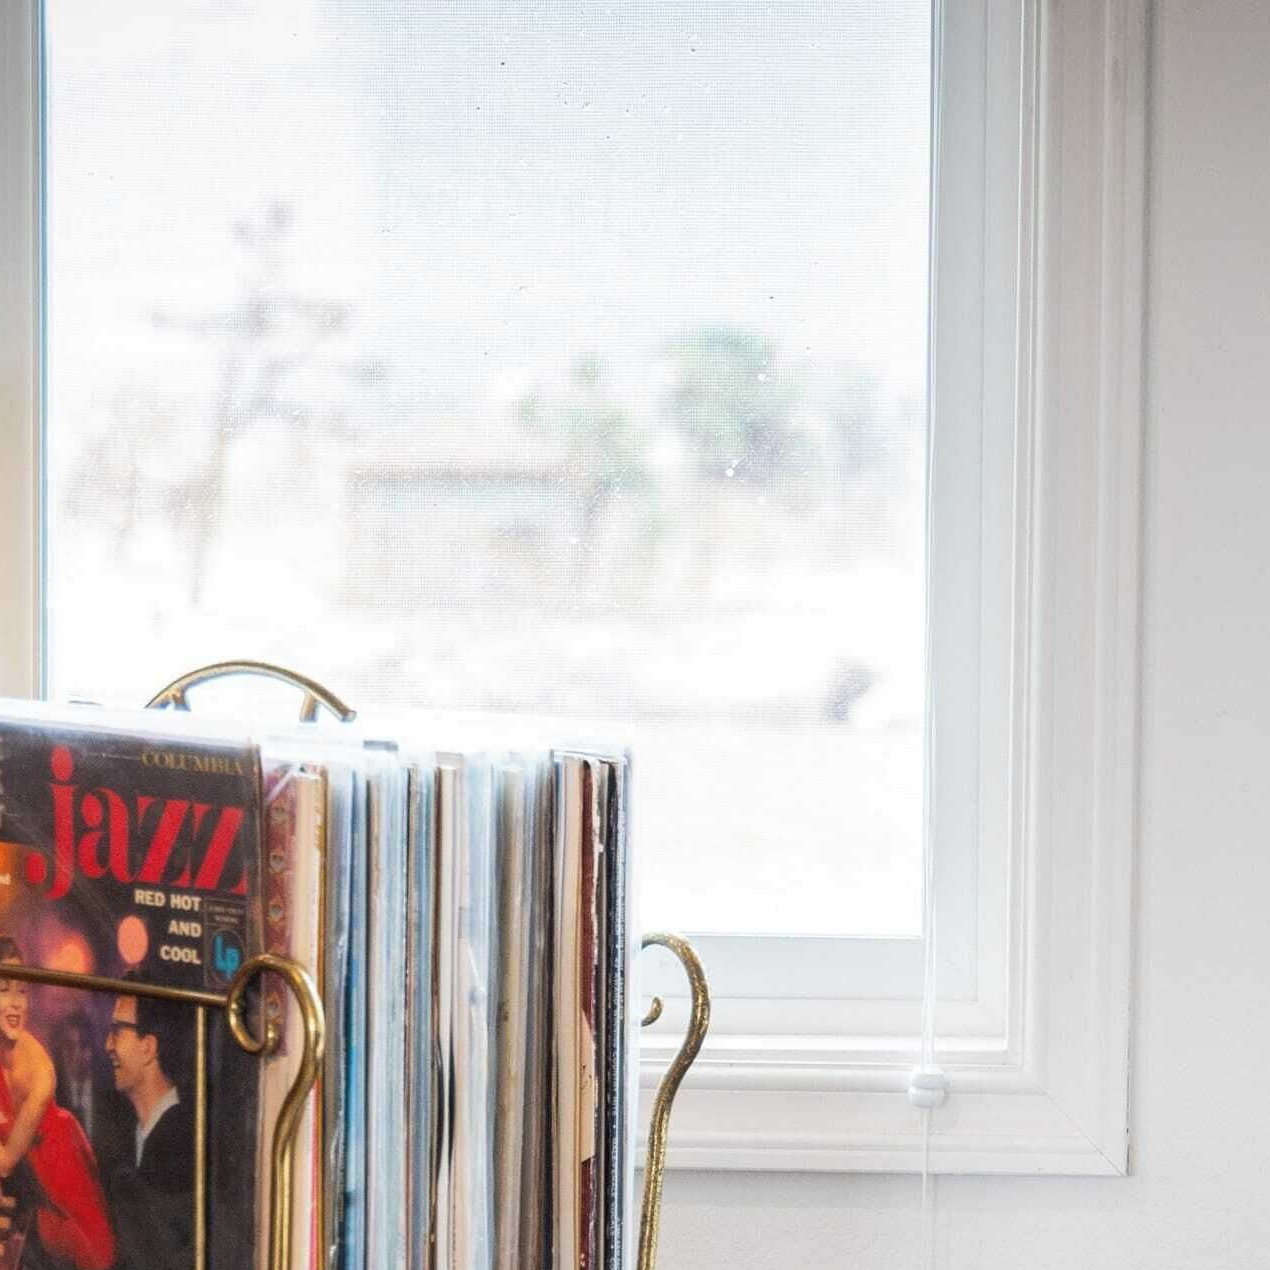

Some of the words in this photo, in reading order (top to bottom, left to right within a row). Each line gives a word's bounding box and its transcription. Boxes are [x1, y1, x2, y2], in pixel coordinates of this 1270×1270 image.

[25, 745, 250, 901] jazz
[134, 888, 166, 908] RED
[170, 893, 203, 912] HOT
[168, 919, 203, 938] AND
[160, 945, 203, 965] COOL
